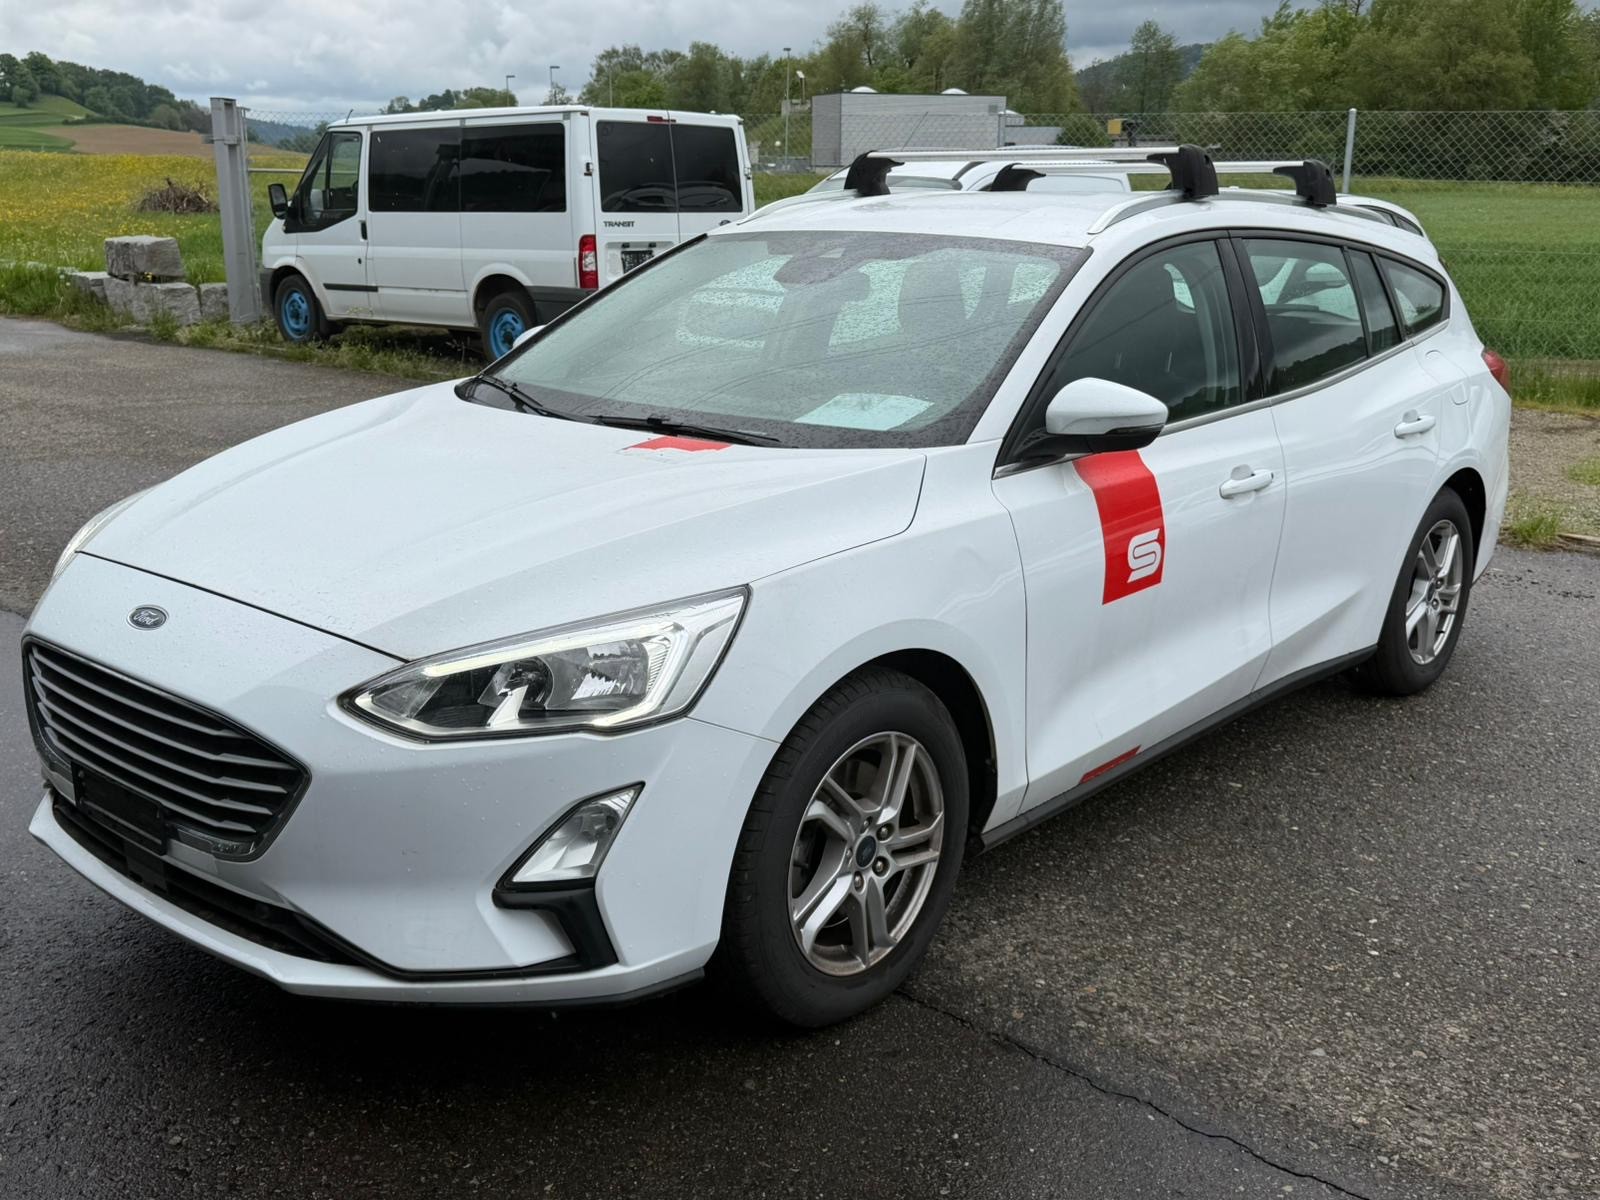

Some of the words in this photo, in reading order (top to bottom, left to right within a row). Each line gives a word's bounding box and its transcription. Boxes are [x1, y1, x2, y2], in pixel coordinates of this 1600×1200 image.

[603, 220, 635, 228] TRANSIT
[1126, 528, 1162, 584] S
[133, 609, 160, 626] Ford
